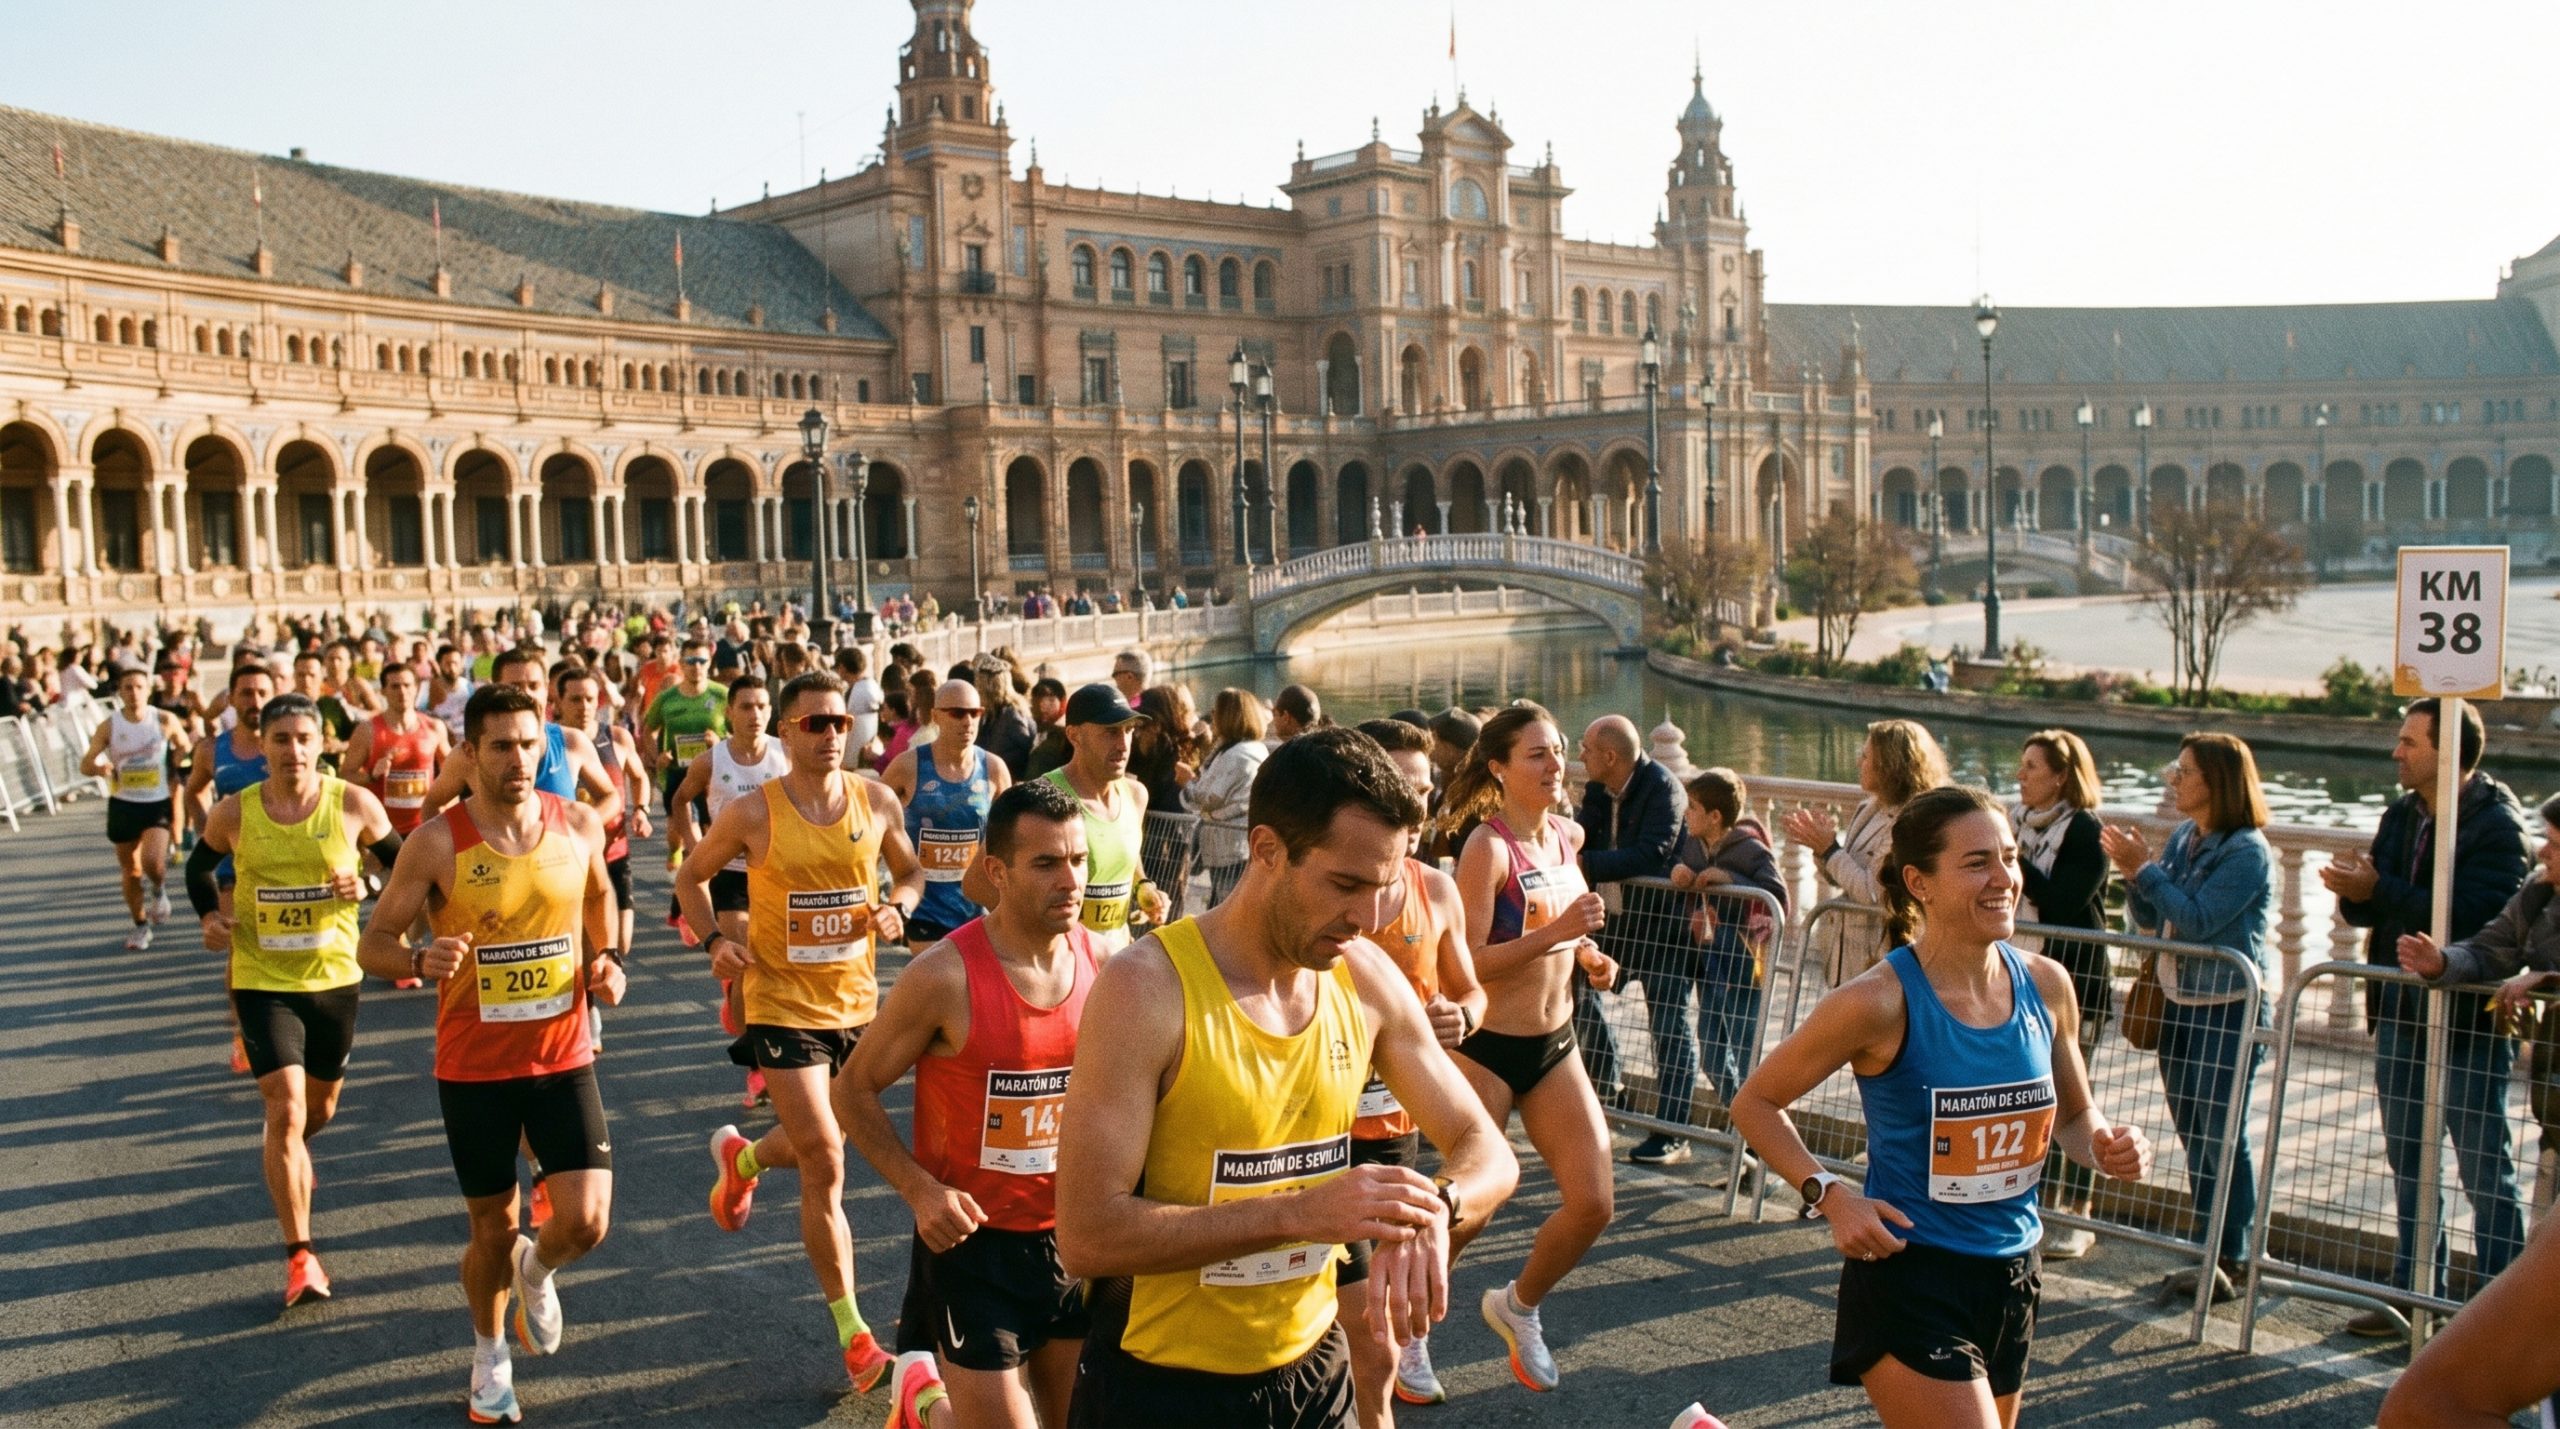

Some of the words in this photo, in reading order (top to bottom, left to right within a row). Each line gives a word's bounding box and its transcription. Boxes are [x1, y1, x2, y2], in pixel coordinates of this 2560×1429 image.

[2420, 571, 2481, 601] KM
[2418, 612, 2482, 654] 38
[278, 908, 312, 927] 421
[811, 912, 852, 937] 603
[481, 948, 525, 961] MARATÓN
[526, 947, 537, 957] DE
[505, 967, 548, 992] 202
[995, 1075, 1048, 1091] MARATÓN
[1049, 1076, 1063, 1089] DE
[1940, 1092, 1996, 1112] MARATÓN
[1999, 1092, 2014, 1107] DE
[1971, 1120, 2026, 1160] 122
[1223, 1154, 1285, 1177] MARATÓN
[1287, 1154, 1303, 1171] DE
[1305, 1145, 1345, 1169] SEVILLA
